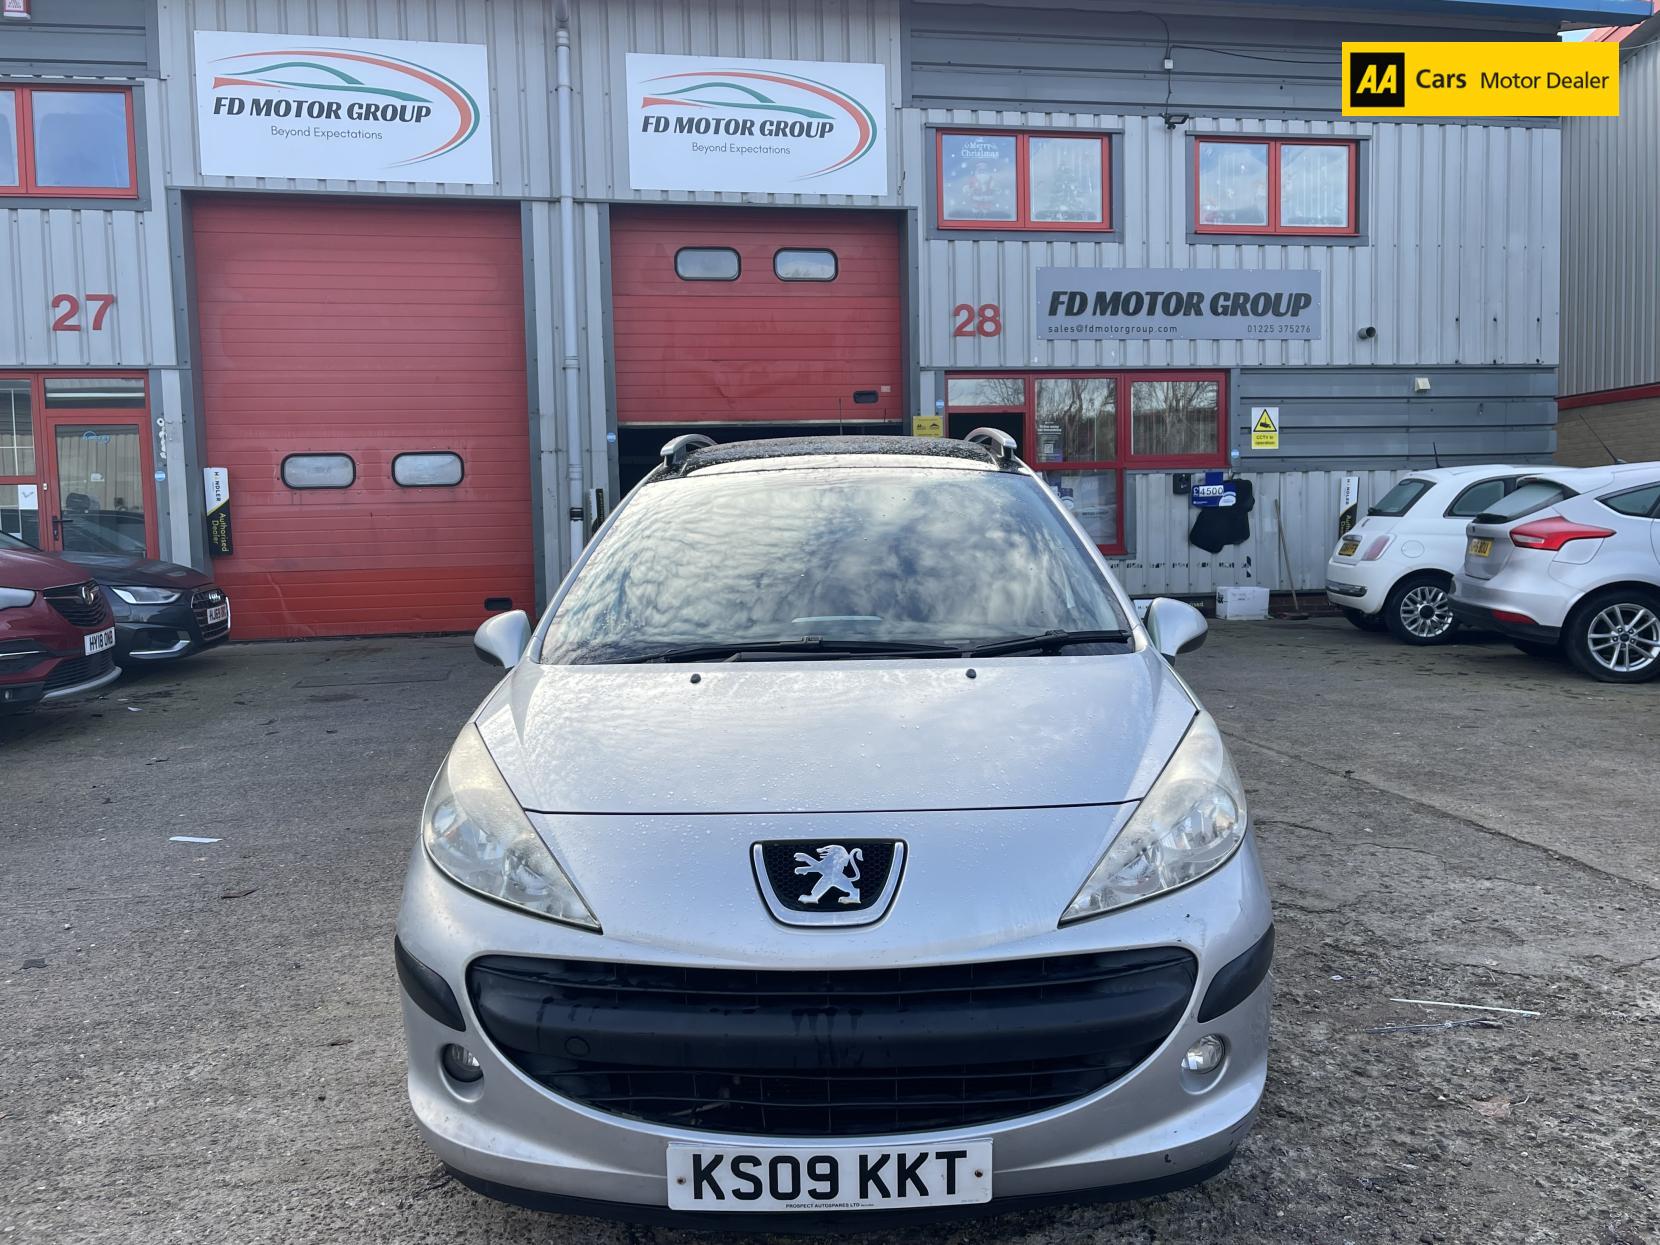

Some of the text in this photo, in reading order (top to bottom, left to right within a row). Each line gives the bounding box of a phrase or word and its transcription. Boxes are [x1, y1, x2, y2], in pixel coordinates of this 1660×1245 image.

[213, 96, 432, 123] FD MOTOR GROUP
[271, 125, 383, 140] Beyond Expectations
[641, 115, 835, 139] FD MOTOR GROUP
[692, 142, 791, 156] Beyond Expectations
[51, 294, 115, 331] 27
[1048, 291, 1312, 317] FD MOTOR GROUP
[952, 303, 1002, 338] 28
[1048, 324, 1178, 335] sales@fdmotorgroup.com
[1247, 324, 1311, 334] 01225 375276
[212, 520, 220, 545] Dealer
[219, 512, 229, 552] Authorised
[692, 1150, 967, 1201] KS09 KKT
